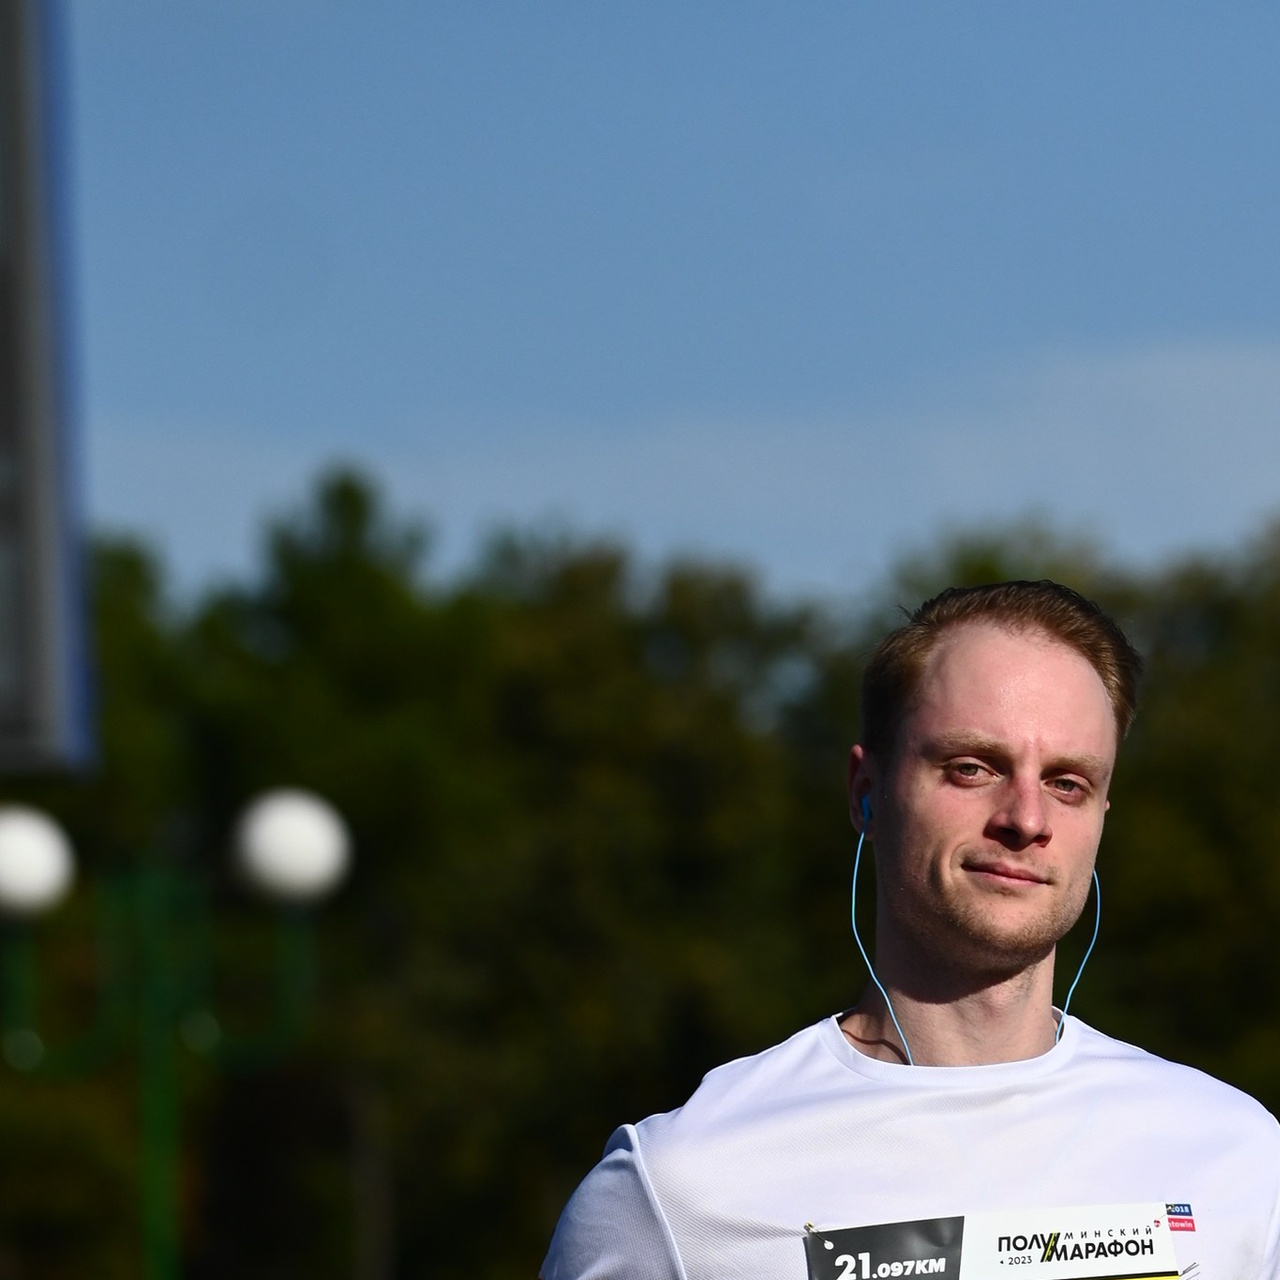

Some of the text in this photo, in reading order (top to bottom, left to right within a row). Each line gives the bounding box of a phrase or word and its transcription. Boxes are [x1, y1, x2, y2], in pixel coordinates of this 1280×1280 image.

[1064, 1225, 1152, 1240] МИНСКИЙ
[998, 1232, 1154, 1263] ПОЛУ МАРАФОН
[1008, 1255, 1033, 1266] 2023
